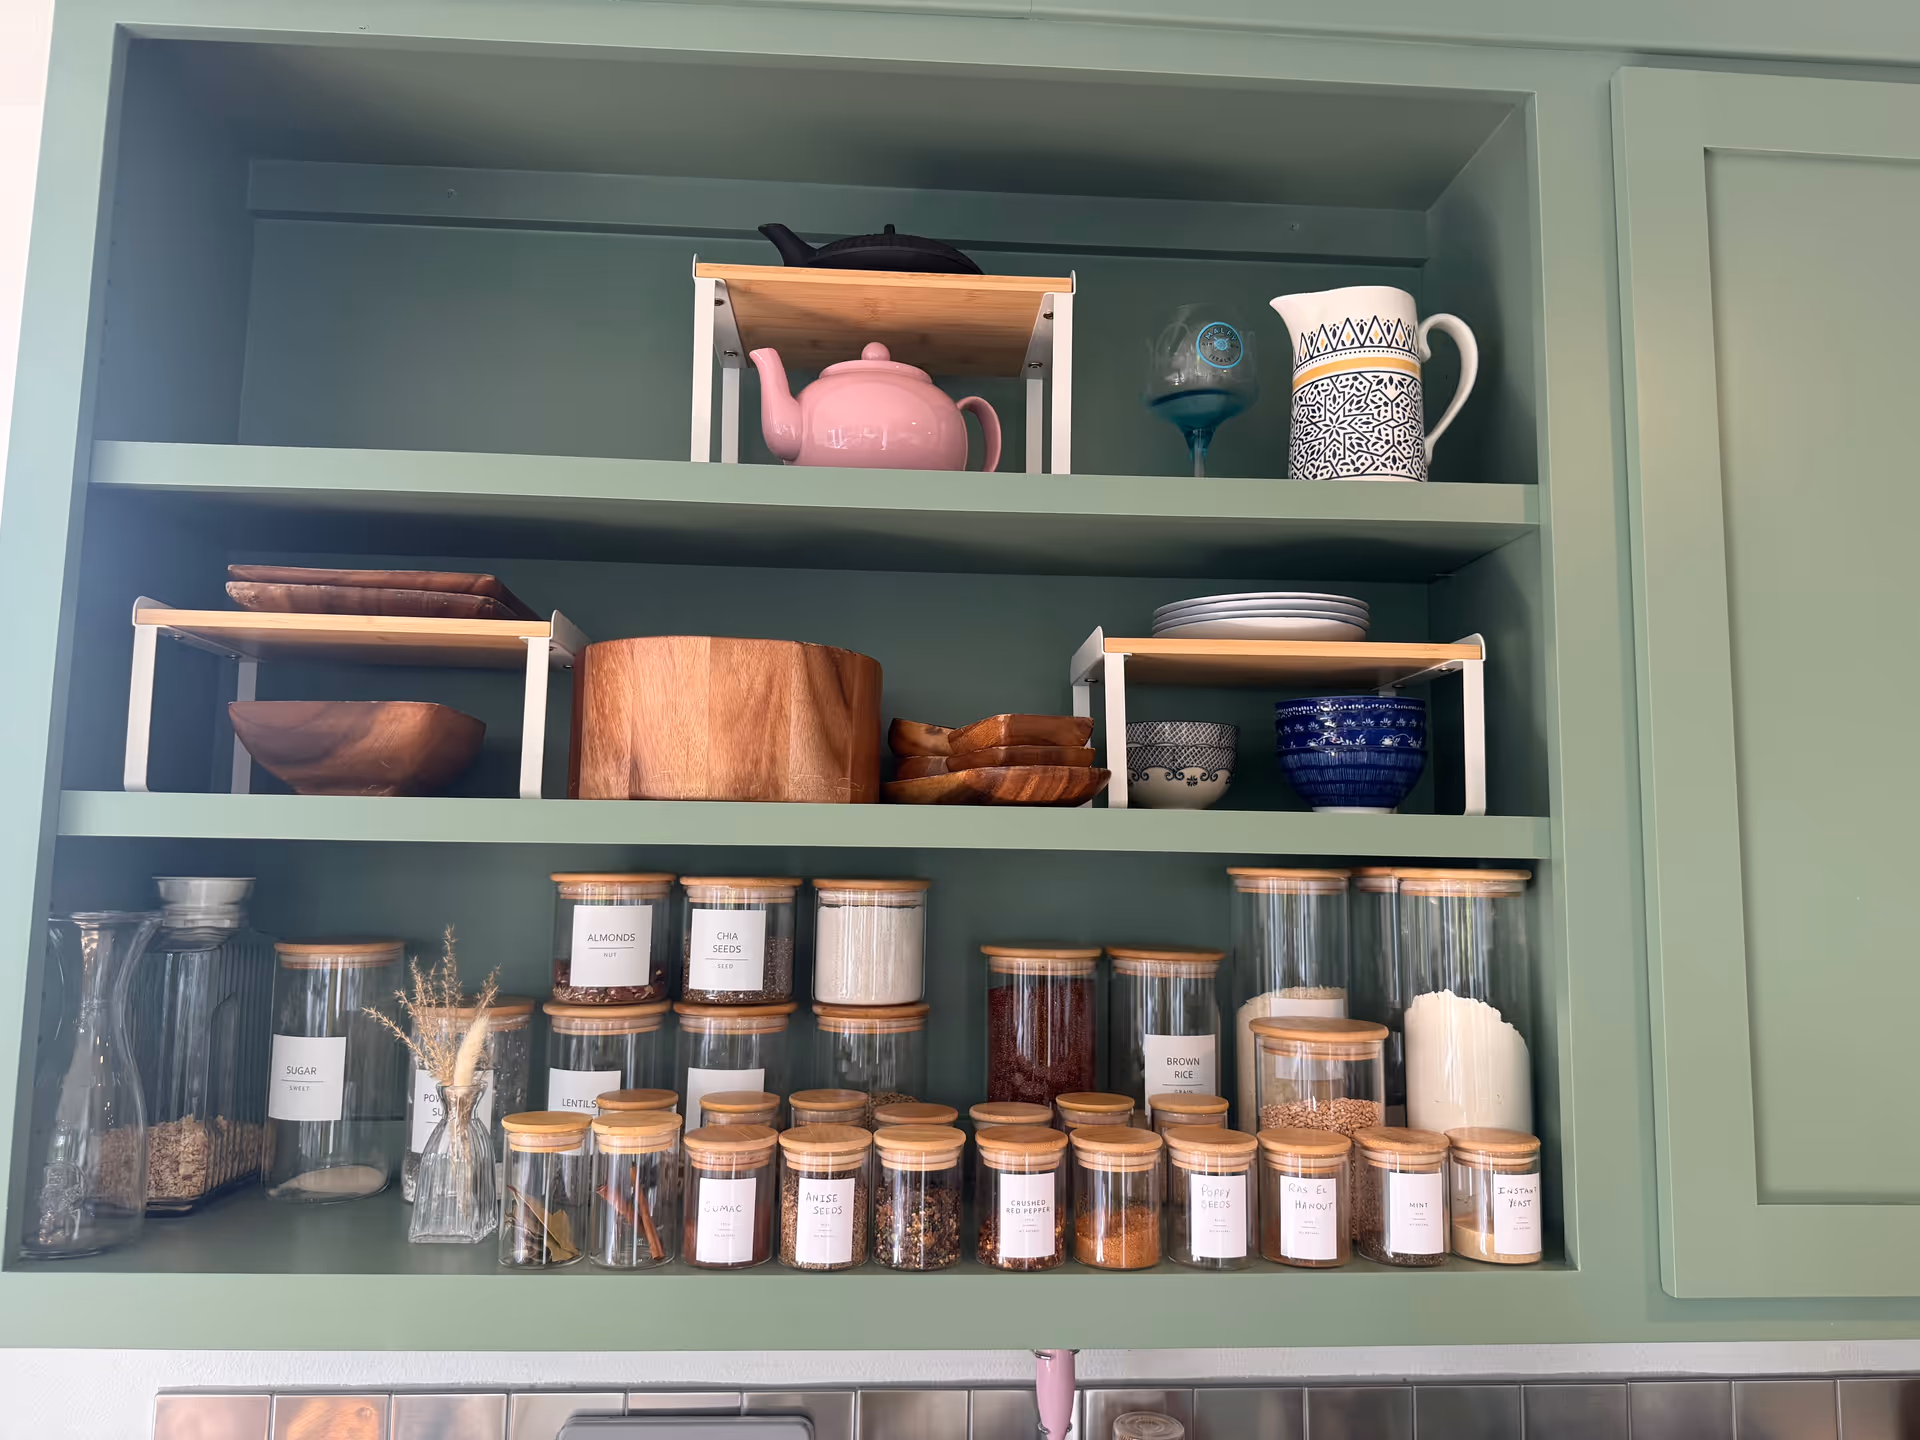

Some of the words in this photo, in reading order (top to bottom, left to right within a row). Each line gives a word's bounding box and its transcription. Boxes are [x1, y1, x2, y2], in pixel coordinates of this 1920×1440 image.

[587, 932, 636, 942] ALMONDS
[716, 932, 739, 941] CHIA
[712, 944, 742, 954] SEEDS
[1166, 1057, 1200, 1066] BROWN
[286, 1065, 317, 1075] SUGAR
[1174, 1070, 1193, 1079] RICE
[562, 1098, 597, 1109] LENTILS
[1201, 1184, 1231, 1199] POPPY
[1288, 1182, 1308, 1194] RAS
[805, 1192, 838, 1203] ANISE
[703, 1201, 743, 1213] SUMAC
[1011, 1199, 1046, 1207] CRUSHED
[1201, 1200, 1231, 1209] SEEDS
[1295, 1200, 1333, 1211] HANOUT
[1508, 1198, 1532, 1208] YEAST
[812, 1206, 843, 1215] SEEDS
[1023, 1206, 1050, 1214] PEPPER
